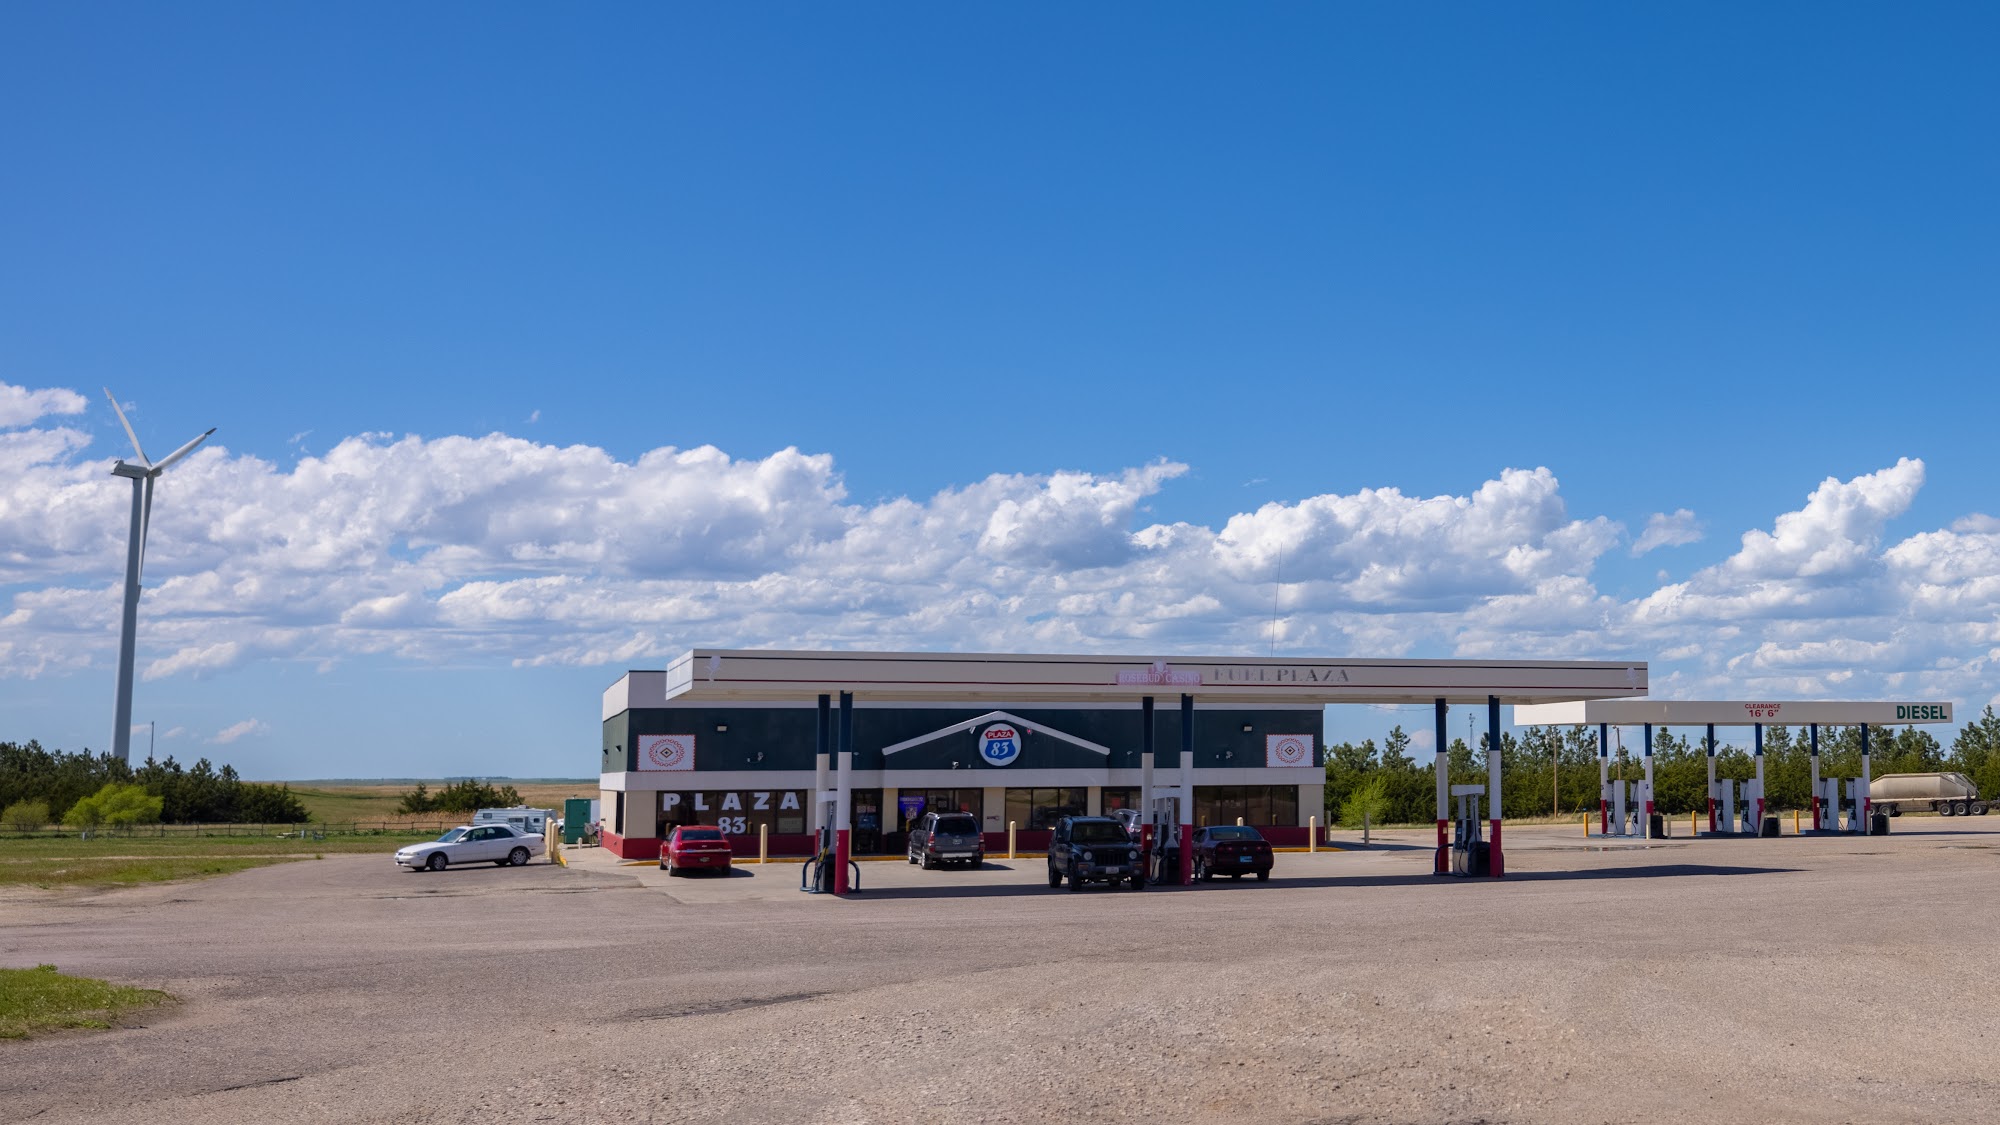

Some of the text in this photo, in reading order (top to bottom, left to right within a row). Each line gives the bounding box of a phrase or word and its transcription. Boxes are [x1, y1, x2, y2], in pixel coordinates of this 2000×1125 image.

[1214, 668, 1349, 681] FUEL PLAZA
[1896, 705, 1948, 720] DIESEL
[991, 742, 1009, 756] 83
[717, 816, 746, 834] 83
